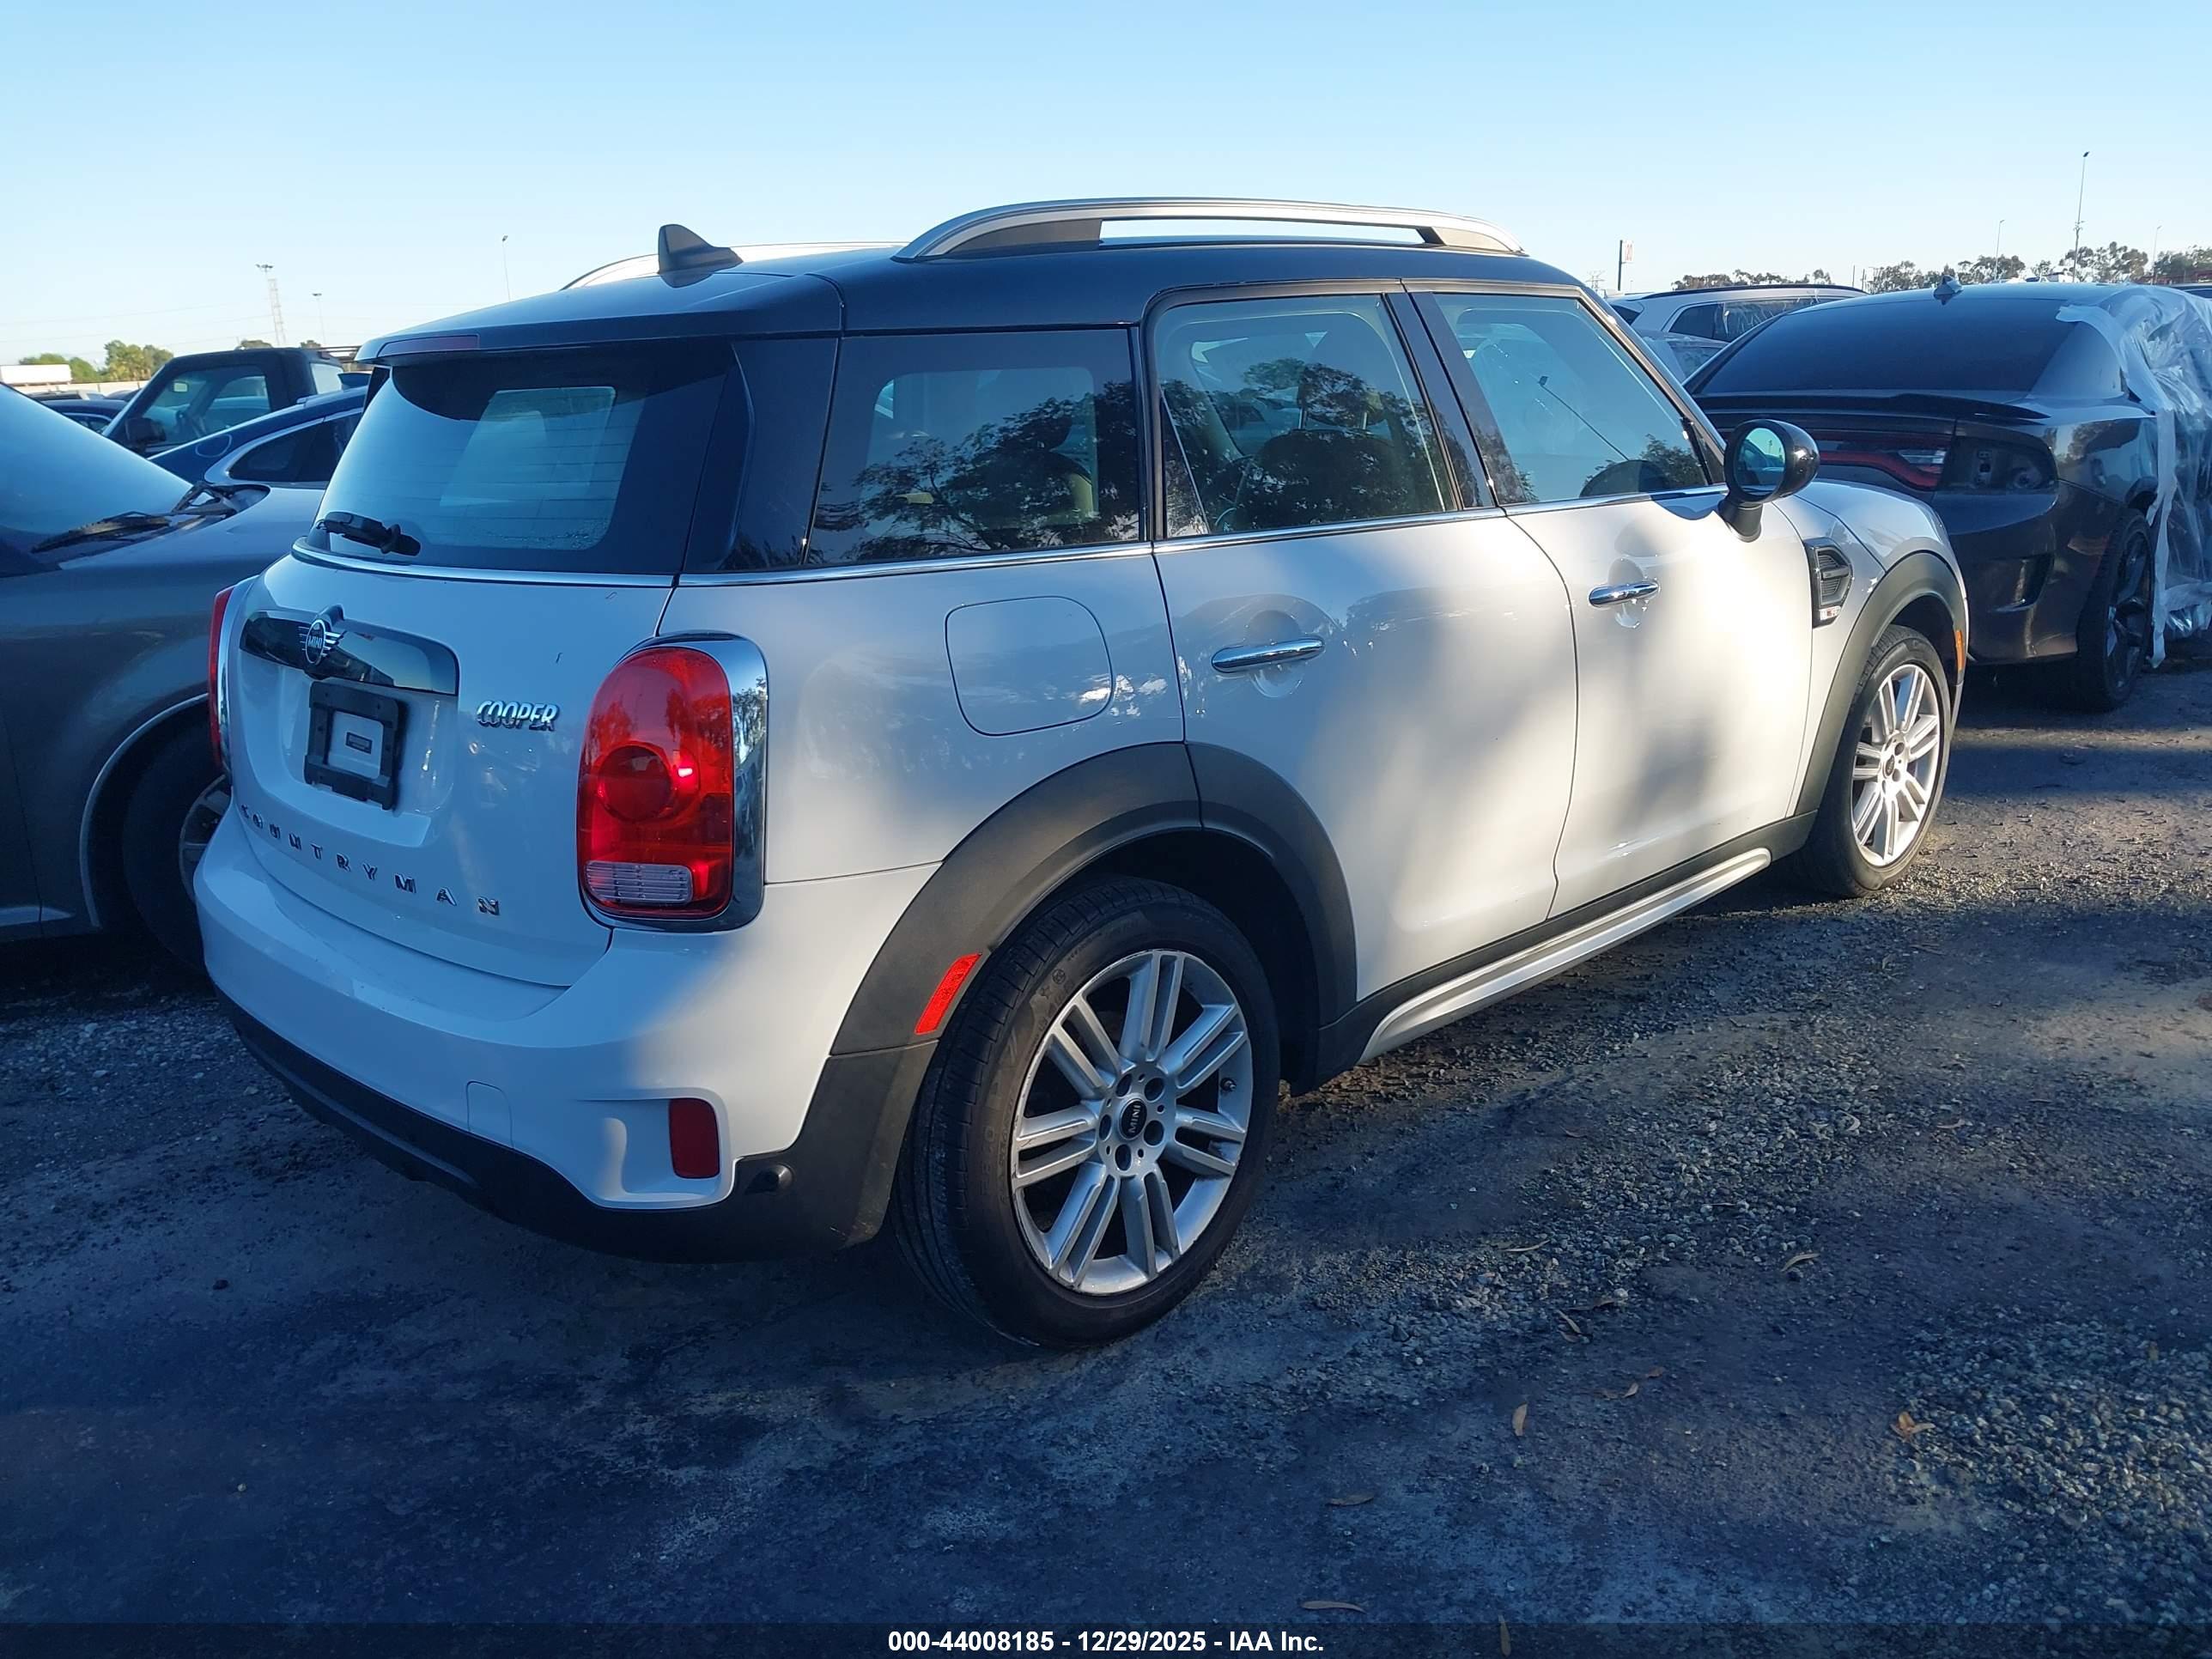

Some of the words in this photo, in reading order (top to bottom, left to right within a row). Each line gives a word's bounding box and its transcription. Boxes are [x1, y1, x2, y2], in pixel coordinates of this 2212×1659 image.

[476, 700, 559, 732] COOPER
[240, 803, 501, 916] COUNTRYMAN
[1127, 1104, 1141, 1133] MINI
